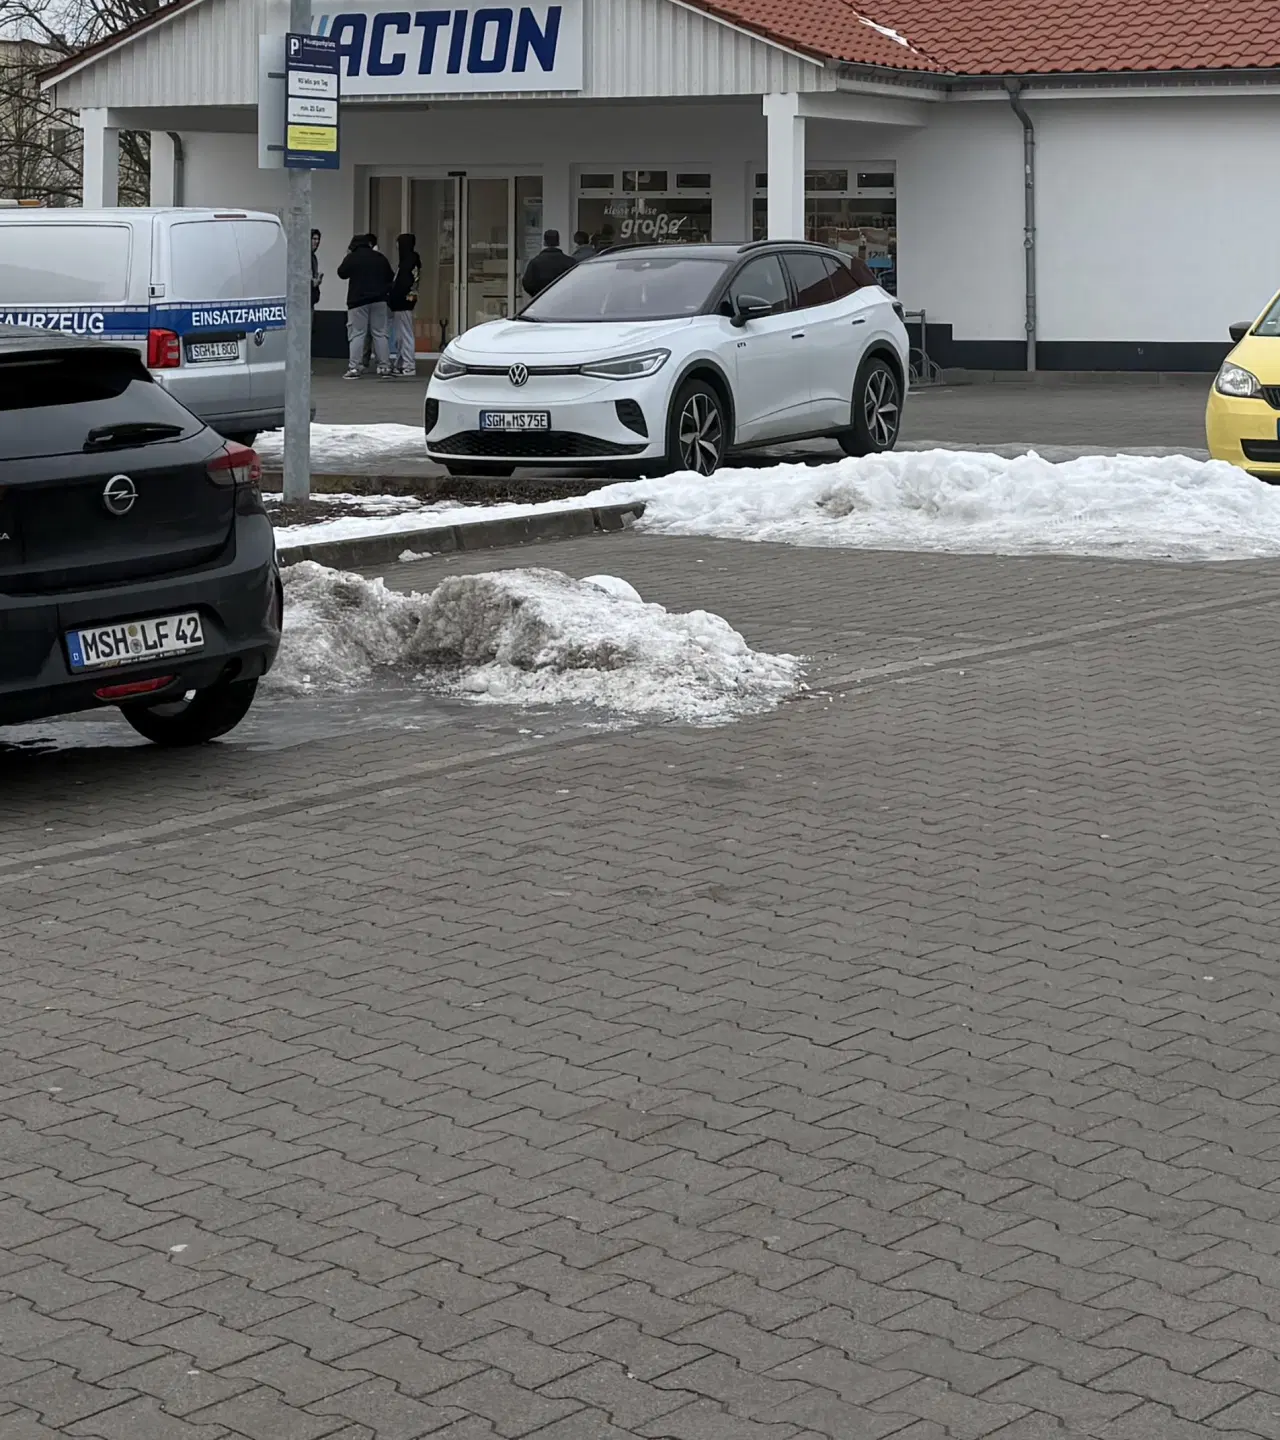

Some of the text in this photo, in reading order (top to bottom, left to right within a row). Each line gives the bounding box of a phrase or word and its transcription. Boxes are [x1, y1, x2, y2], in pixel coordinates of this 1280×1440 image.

[290, 38, 299, 55] P
[329, 6, 562, 77] ACTION
[191, 306, 287, 326] EINSATZFAHRZEU
[486, 414, 505, 427] SGH
[81, 625, 130, 661] MSH
[140, 620, 169, 651] LF
[175, 616, 202, 645] 42
